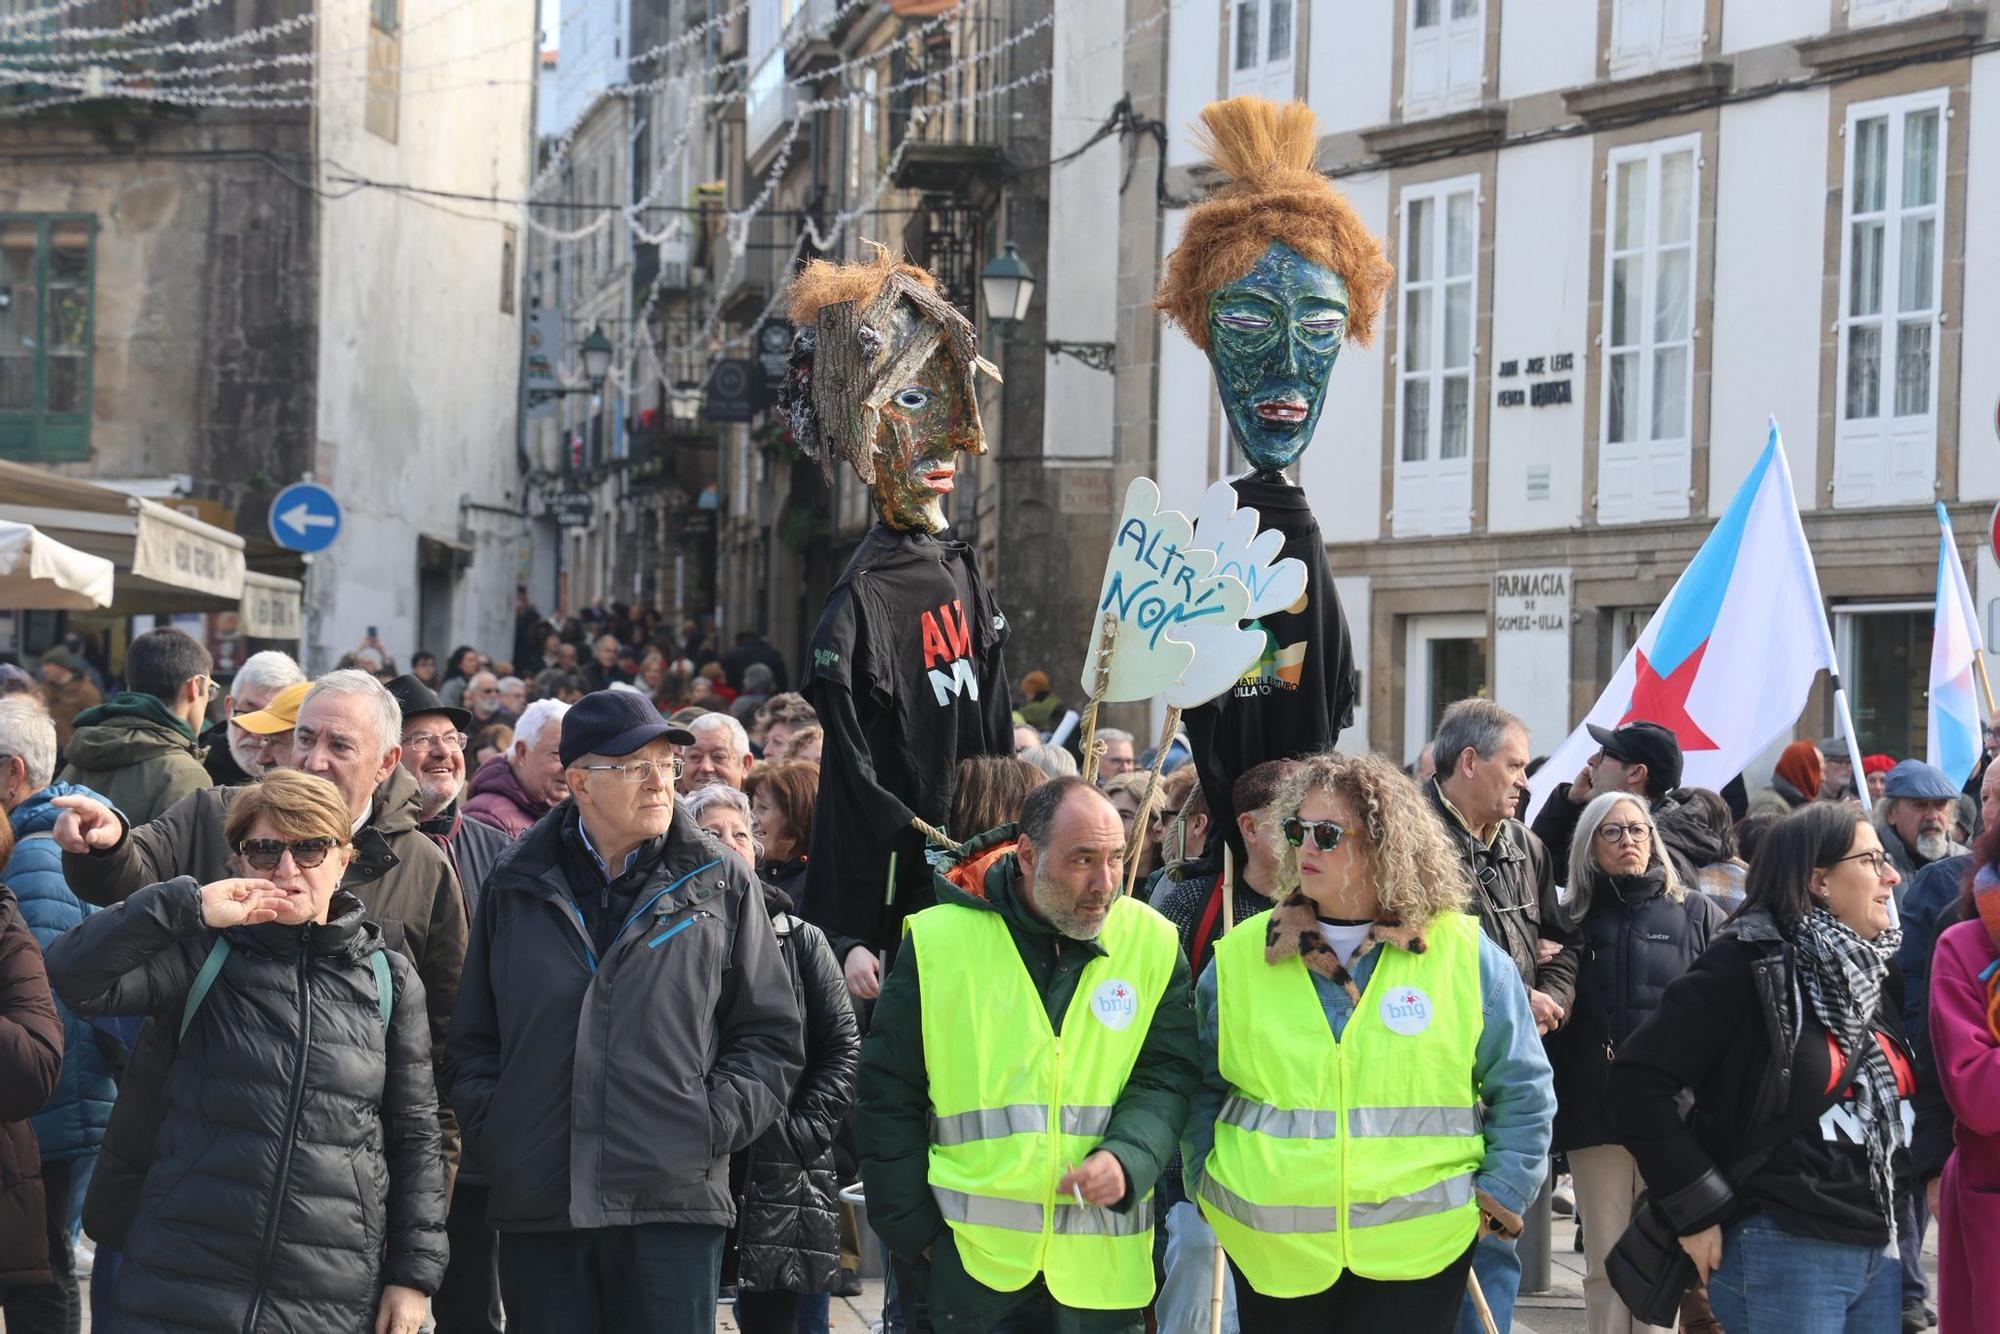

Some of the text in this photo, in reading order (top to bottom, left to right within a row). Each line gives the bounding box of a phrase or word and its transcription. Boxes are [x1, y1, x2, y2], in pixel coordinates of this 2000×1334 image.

[1497, 574, 1564, 596] FARMACIA
[1234, 686, 1258, 698] ULLA
[1097, 996, 1132, 1015] bng
[1385, 1003, 1426, 1019] bng
